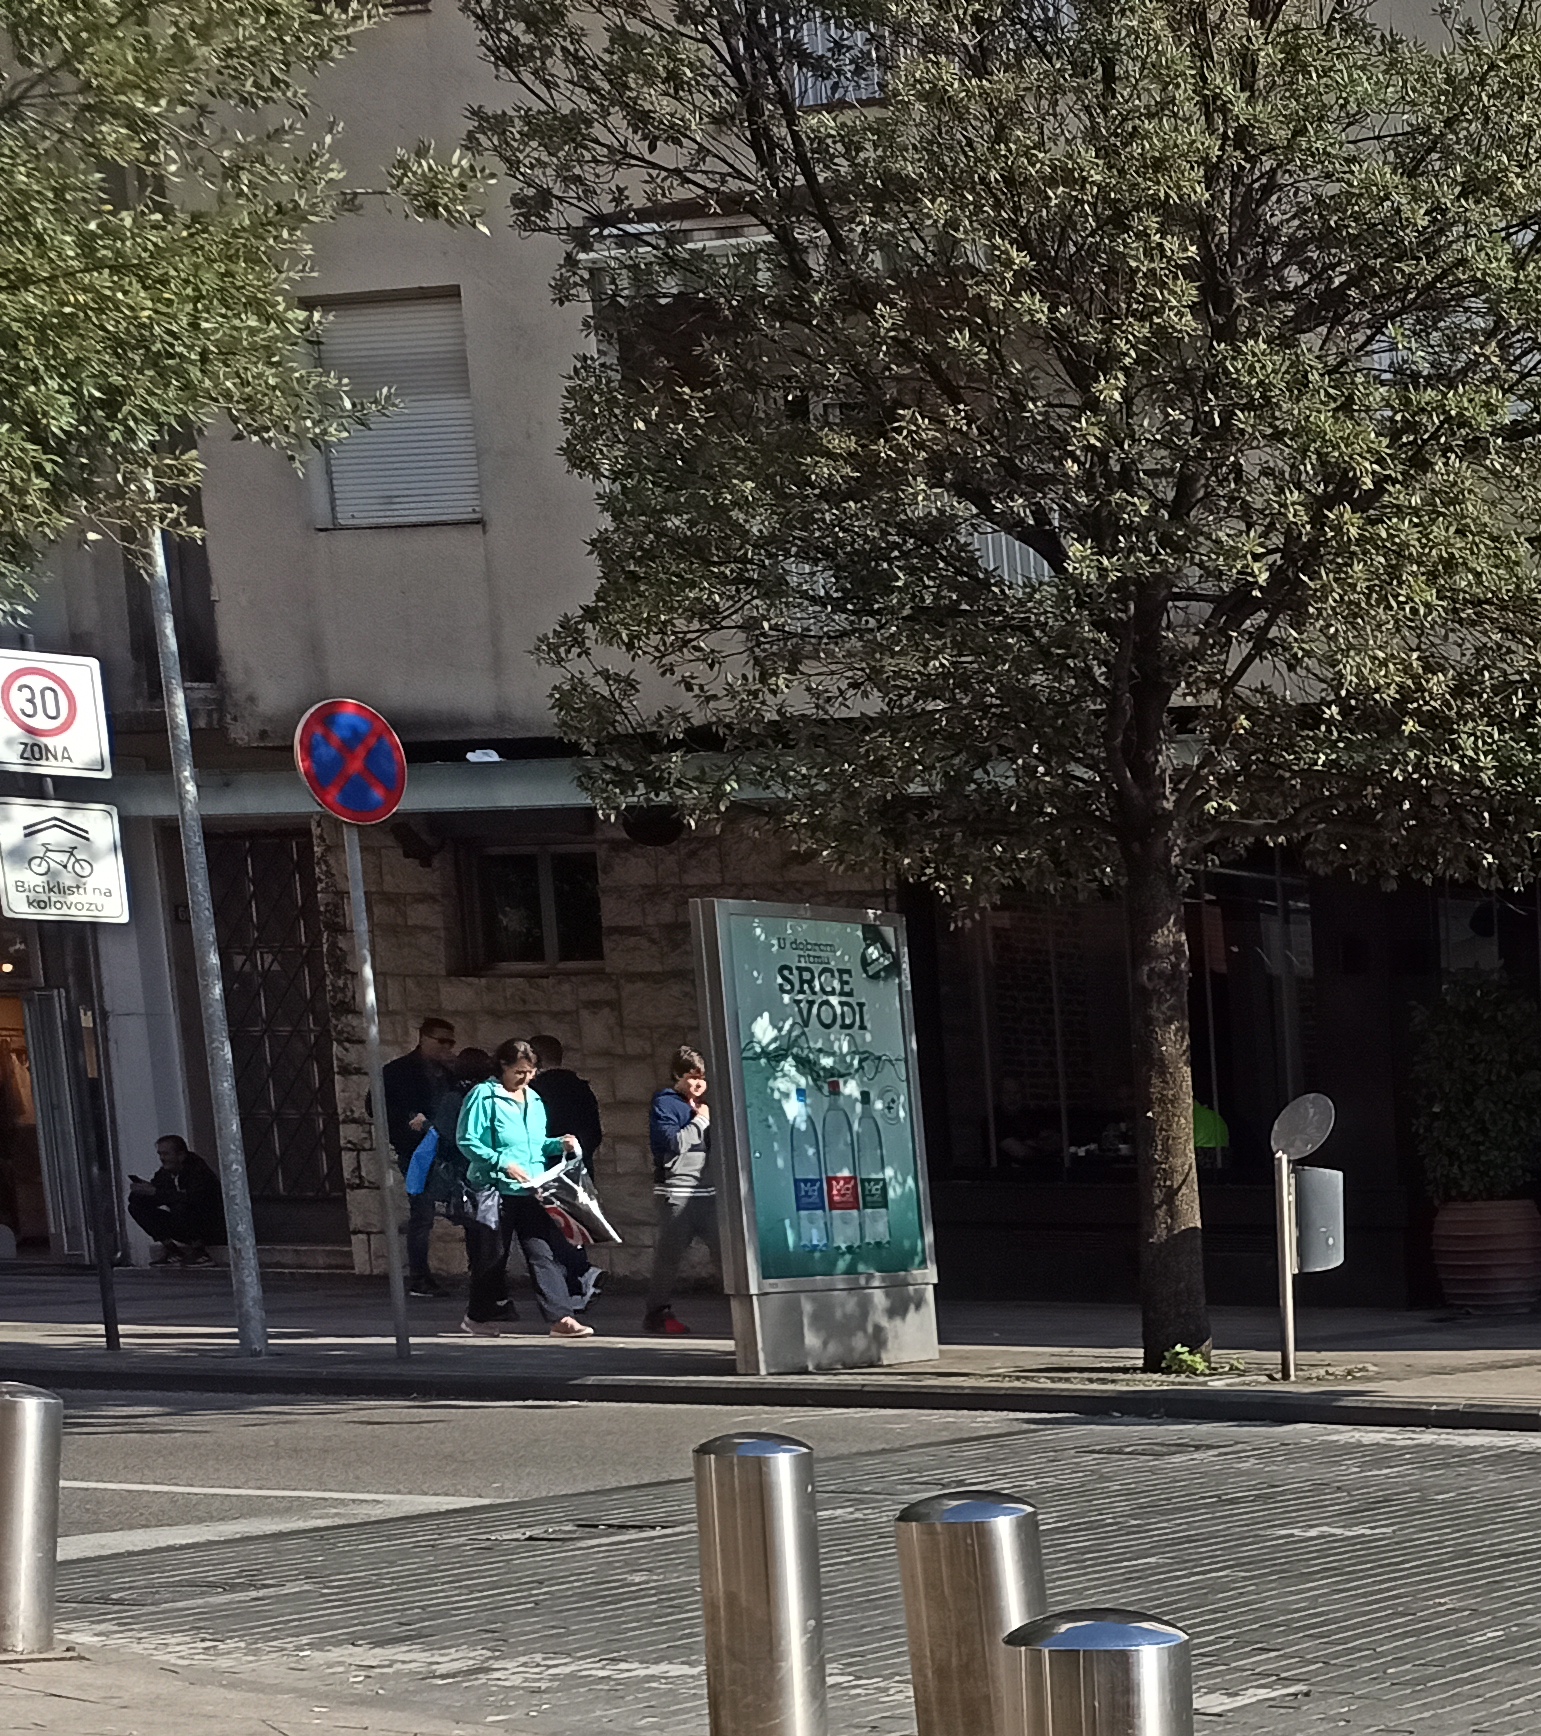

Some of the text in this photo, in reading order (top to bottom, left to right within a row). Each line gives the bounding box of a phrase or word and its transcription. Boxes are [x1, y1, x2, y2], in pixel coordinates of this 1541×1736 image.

[17, 684, 60, 720] 30
[18, 741, 73, 763] ZONA
[15, 879, 112, 897] Biciklisti na
[26, 895, 104, 912] kolovozu
[777, 937, 787, 949] U
[778, 964, 854, 997] SRCE
[793, 998, 868, 1030] VODI
